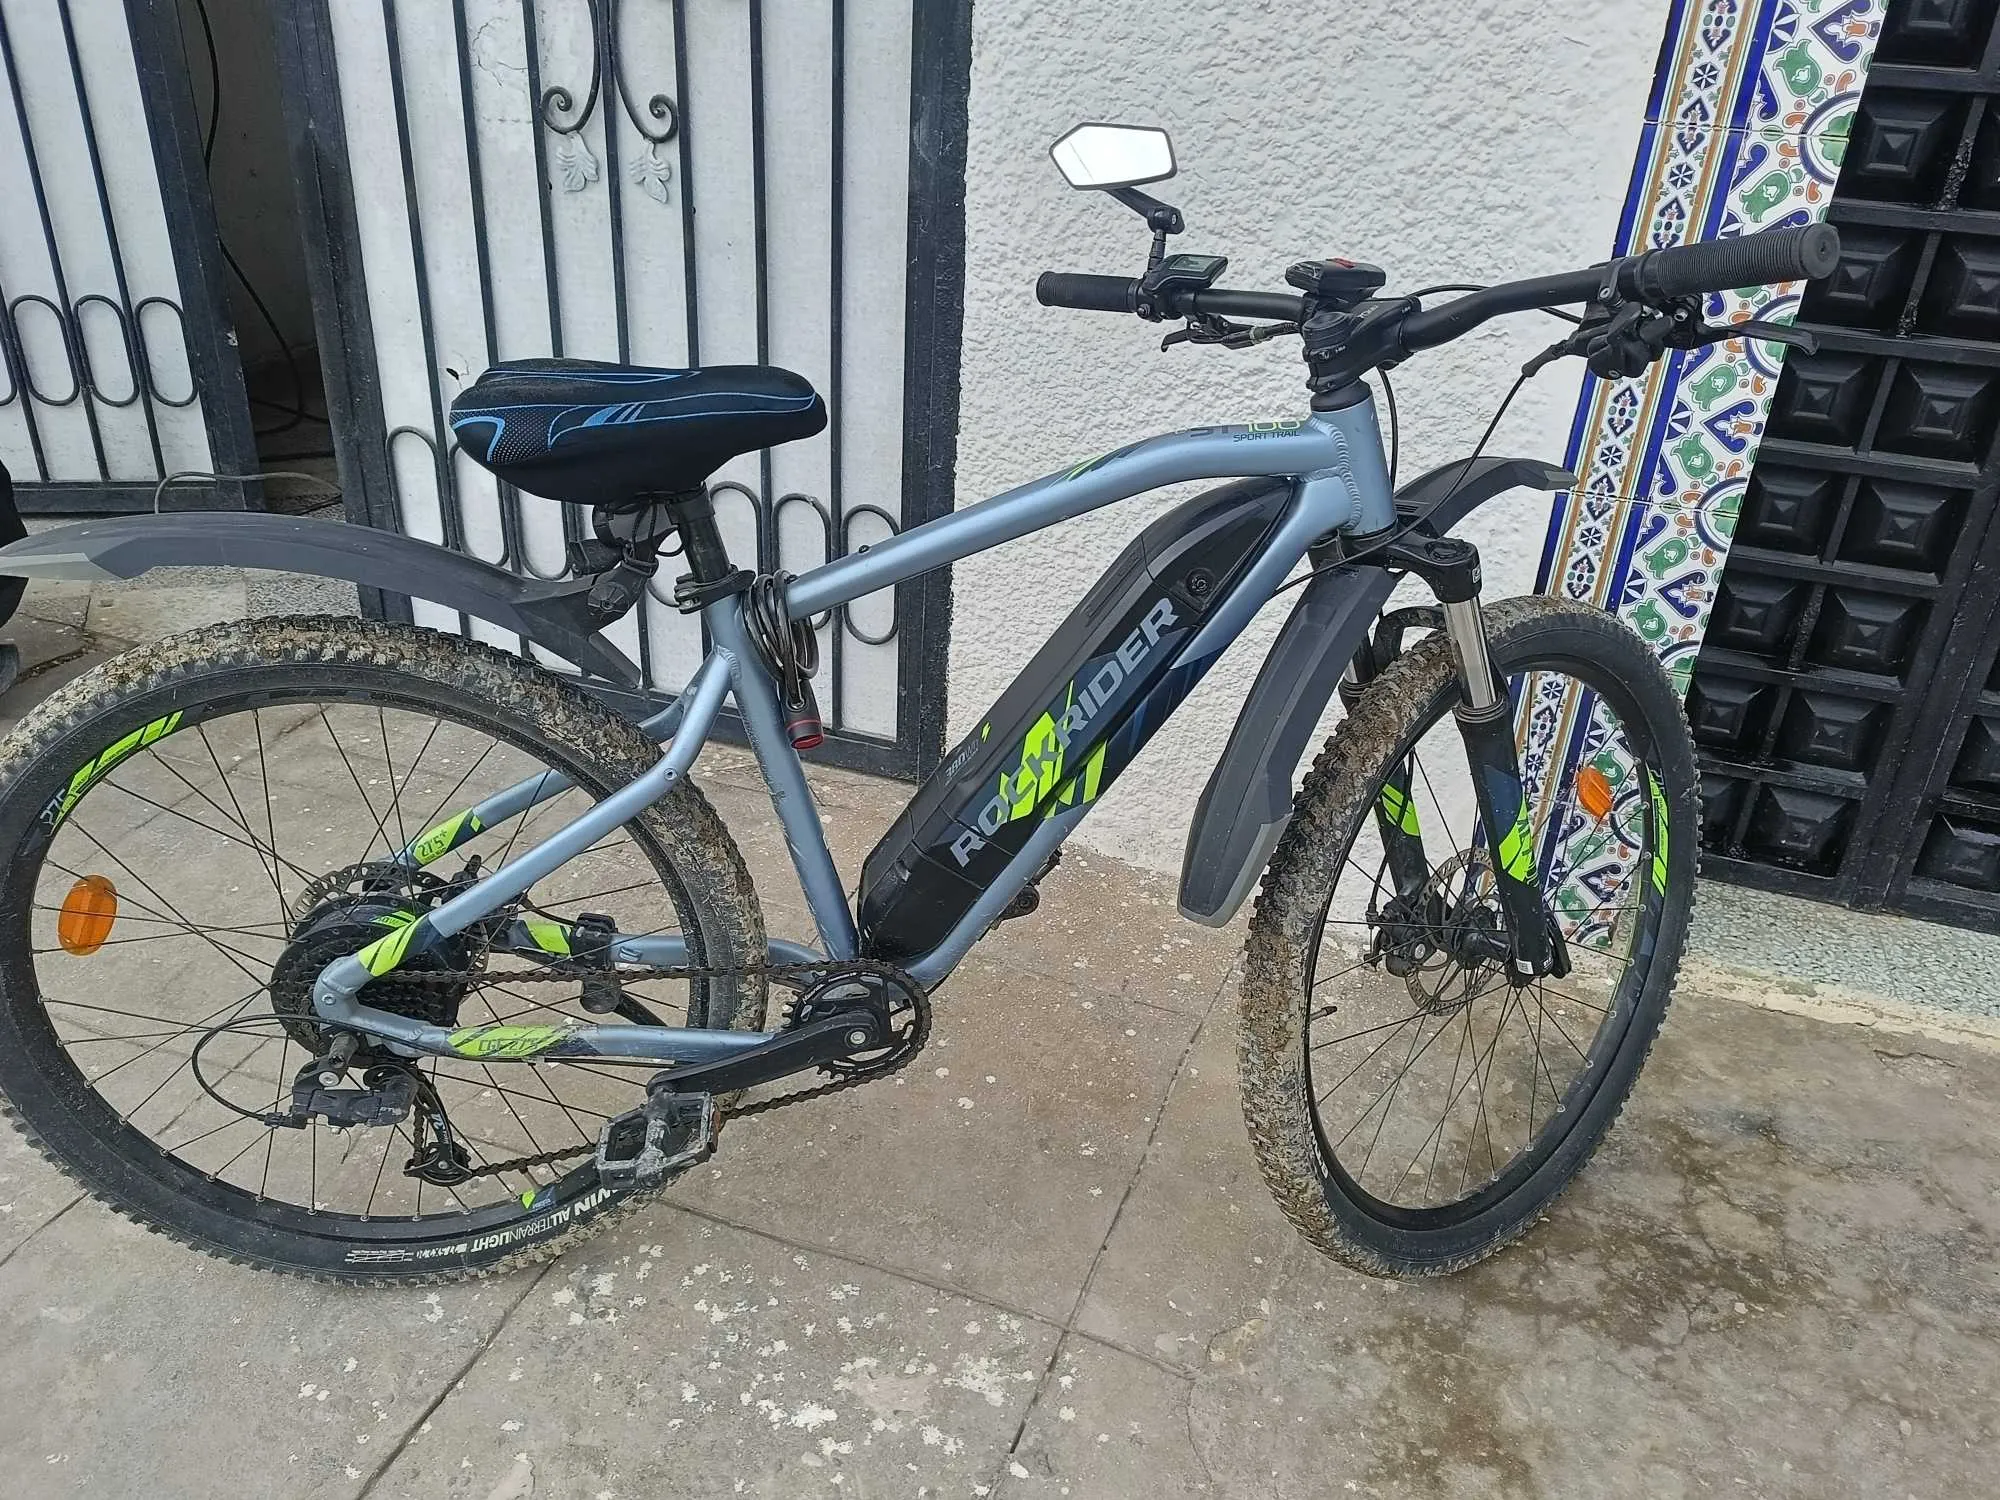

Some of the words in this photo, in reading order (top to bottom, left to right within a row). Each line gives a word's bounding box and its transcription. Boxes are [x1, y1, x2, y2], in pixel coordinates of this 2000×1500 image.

[1233, 431, 1268, 443] SPORT
[1271, 430, 1301, 438] TRAIL
[950, 597, 1180, 868] ROCKRIDER
[470, 1206, 572, 1253] ALLTERRAINLIGHT
